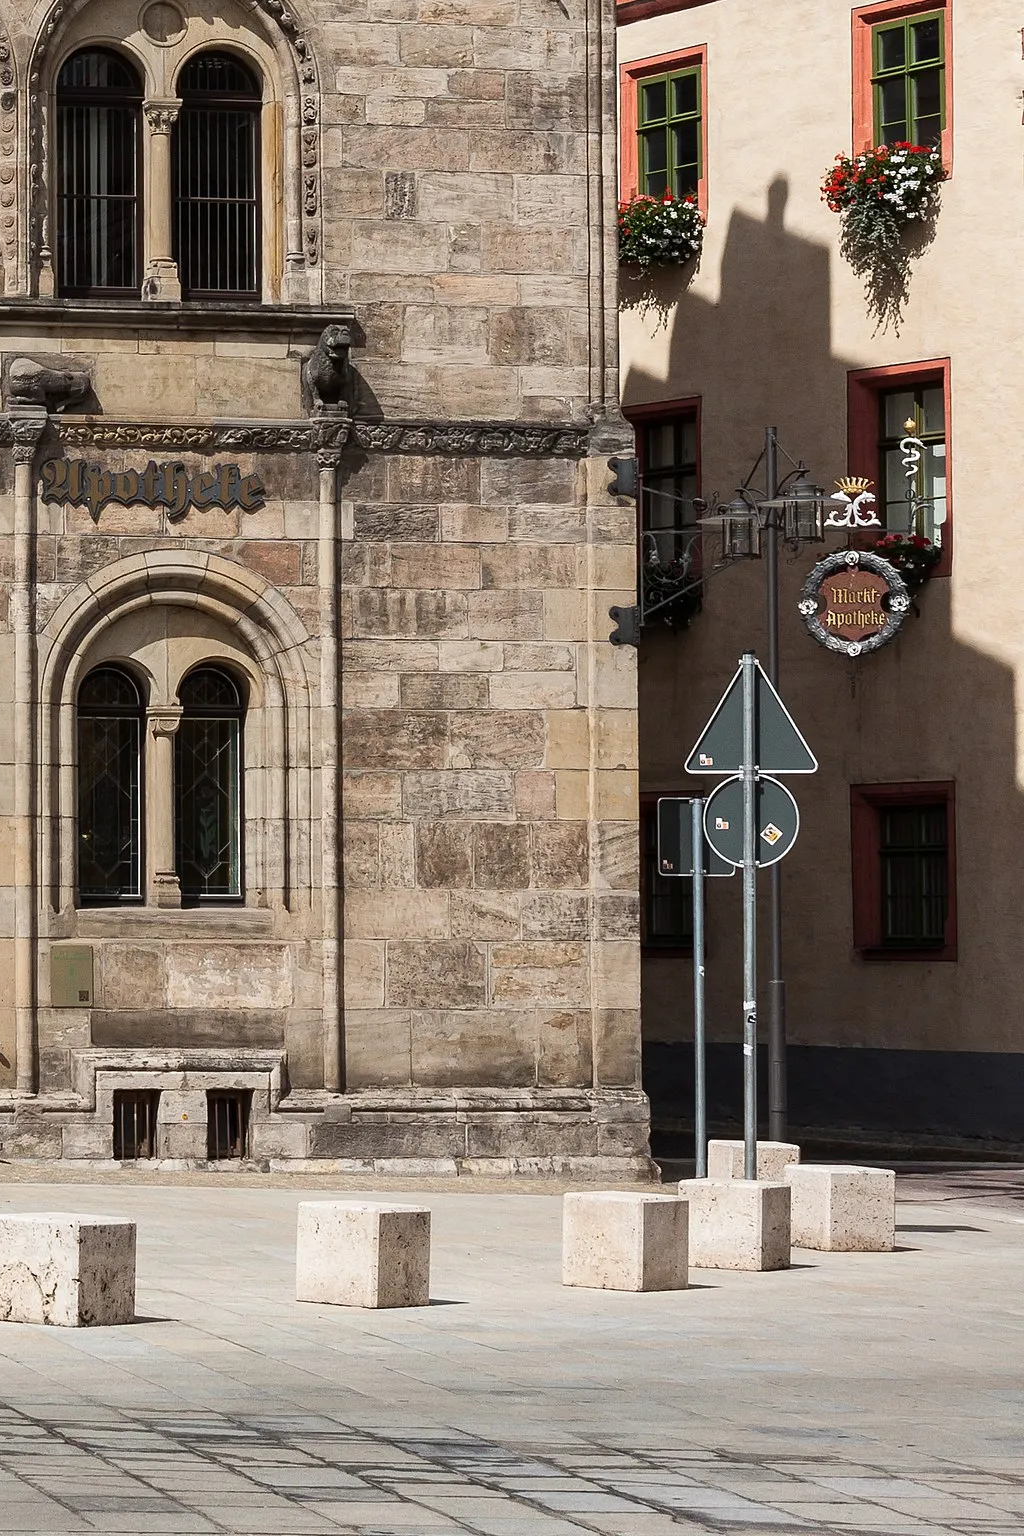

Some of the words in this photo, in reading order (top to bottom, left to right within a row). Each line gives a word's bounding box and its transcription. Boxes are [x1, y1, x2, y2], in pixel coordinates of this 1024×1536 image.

[41, 458, 266, 524] Apotheke
[831, 587, 881, 604] Markt-
[825, 609, 886, 629] Apotheke
